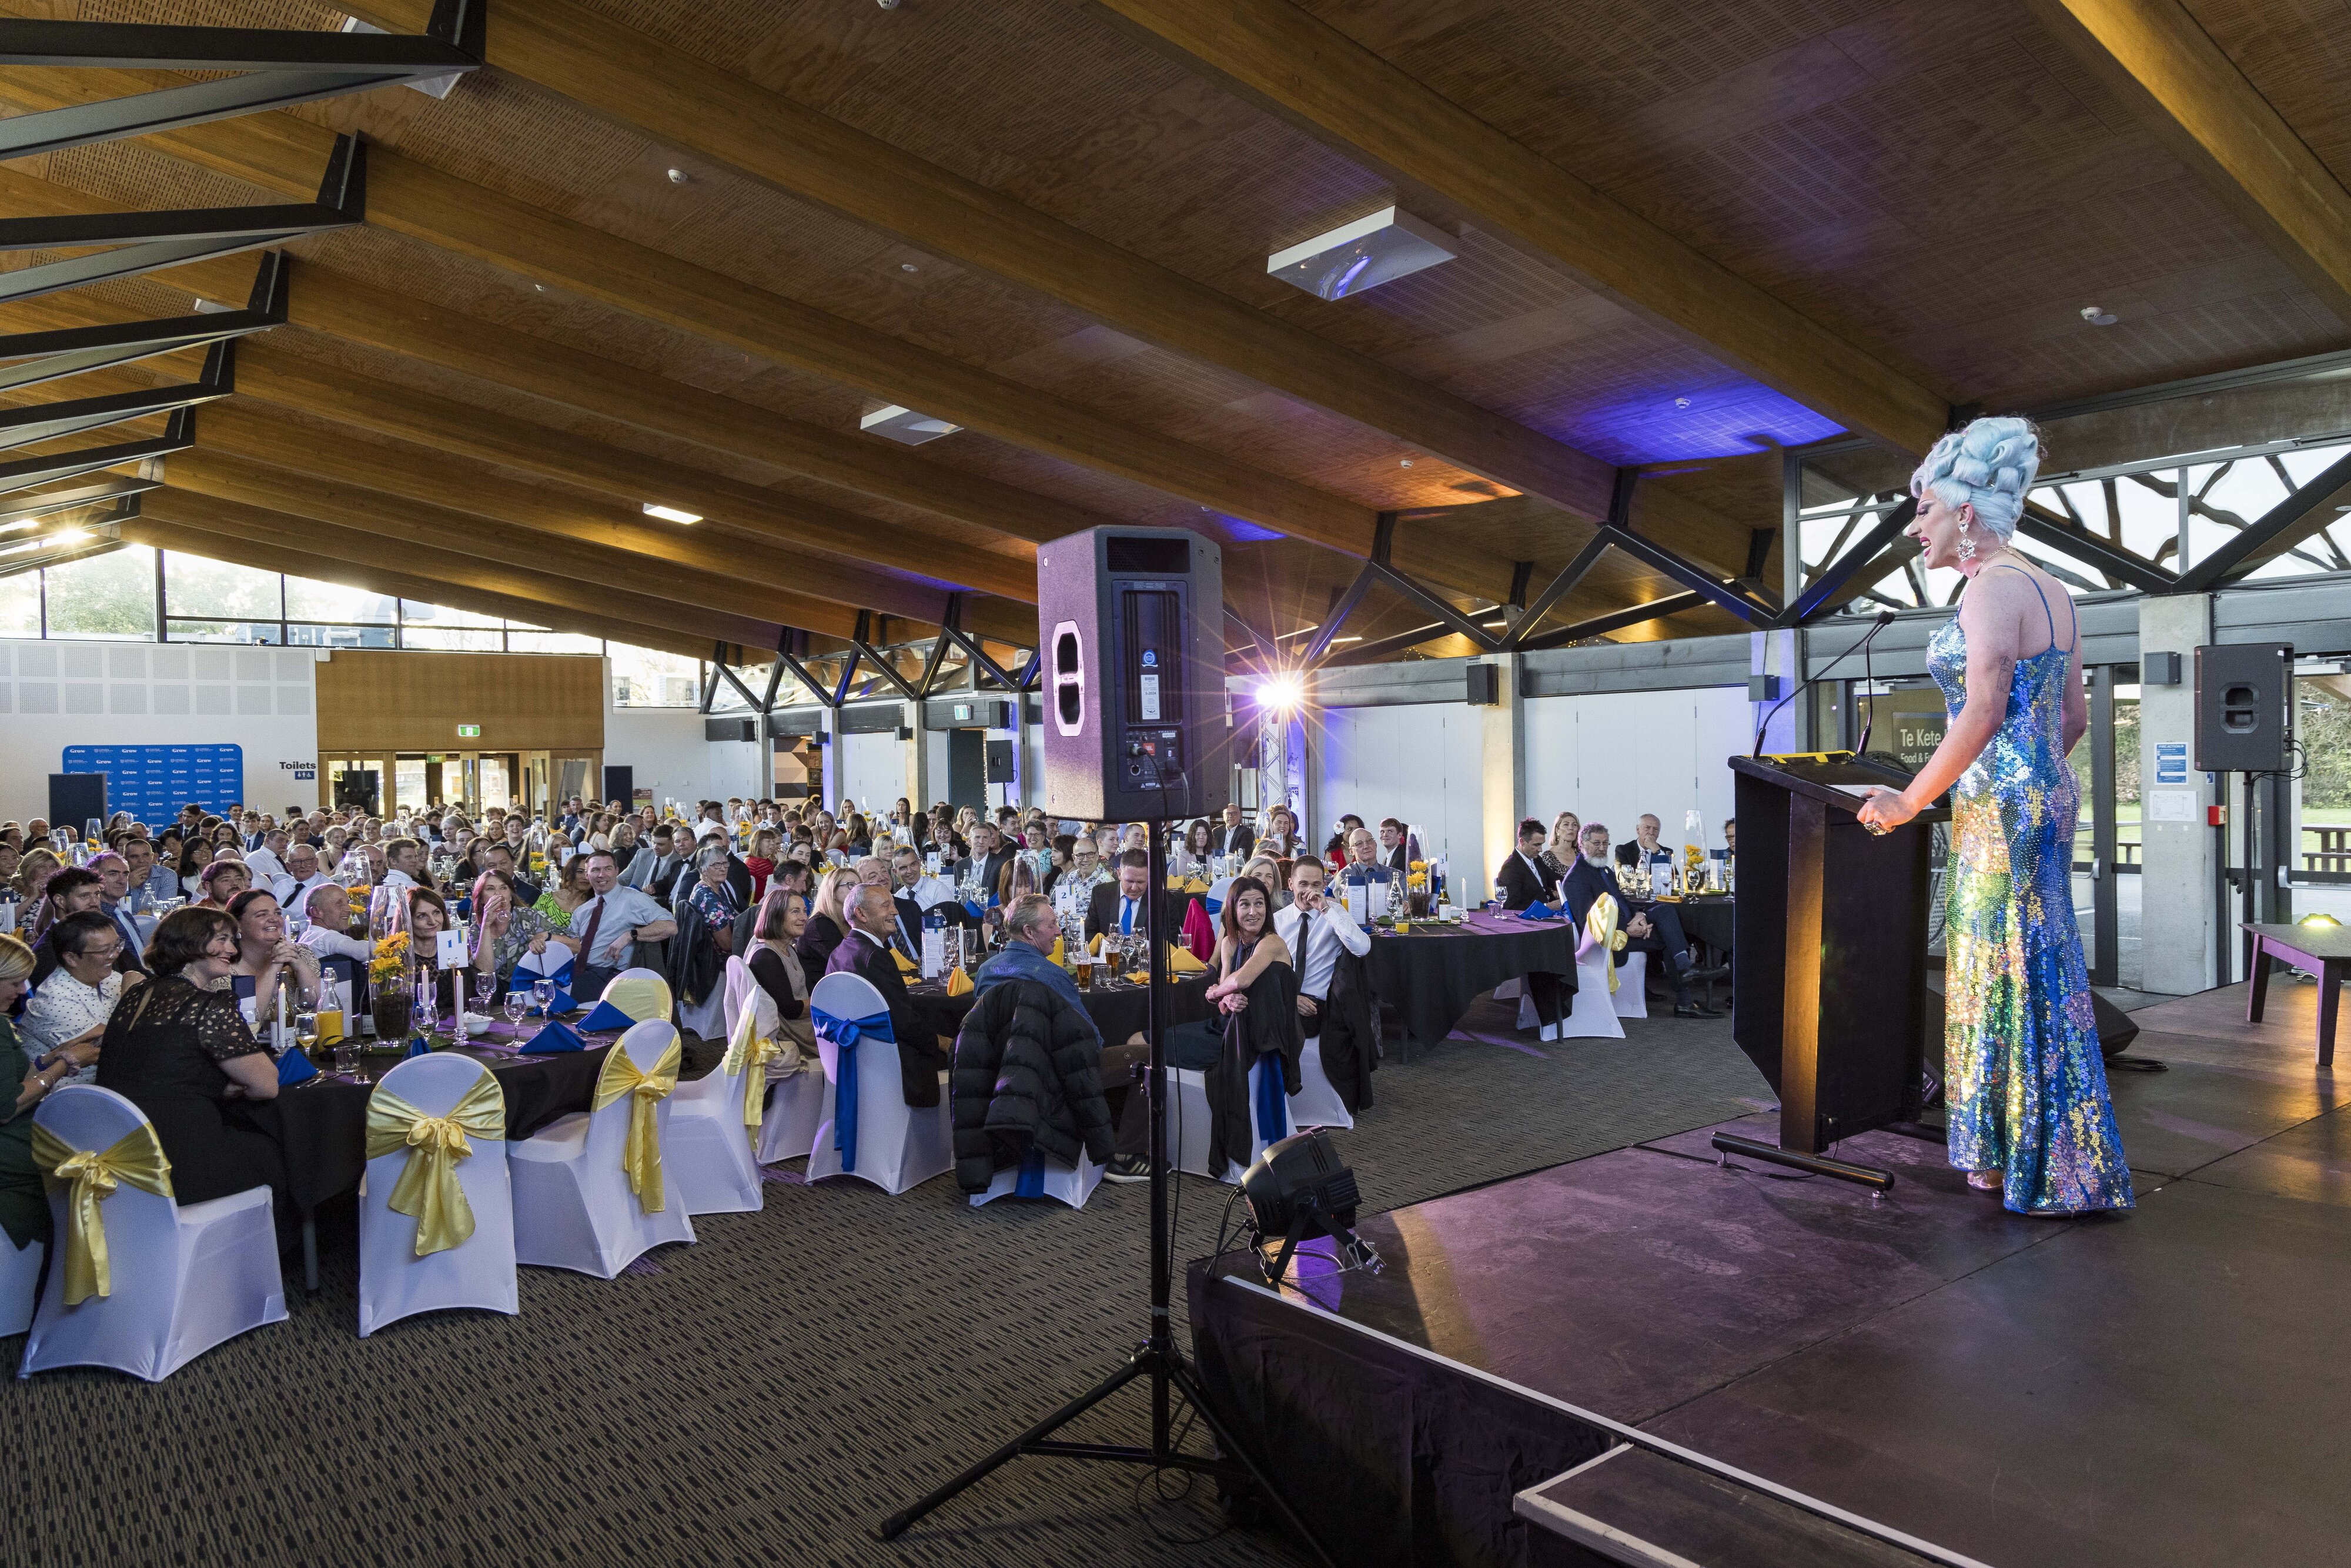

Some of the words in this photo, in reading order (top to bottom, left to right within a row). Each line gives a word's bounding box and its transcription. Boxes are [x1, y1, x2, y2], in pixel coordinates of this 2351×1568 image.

[1900, 729, 1914, 747] Te
[1917, 728, 1941, 747] Kete
[1901, 753, 1917, 763] Food
[1918, 753, 1924, 763] &
[279, 761, 316, 770] Toilets
[447, 940, 452, 948] 1
